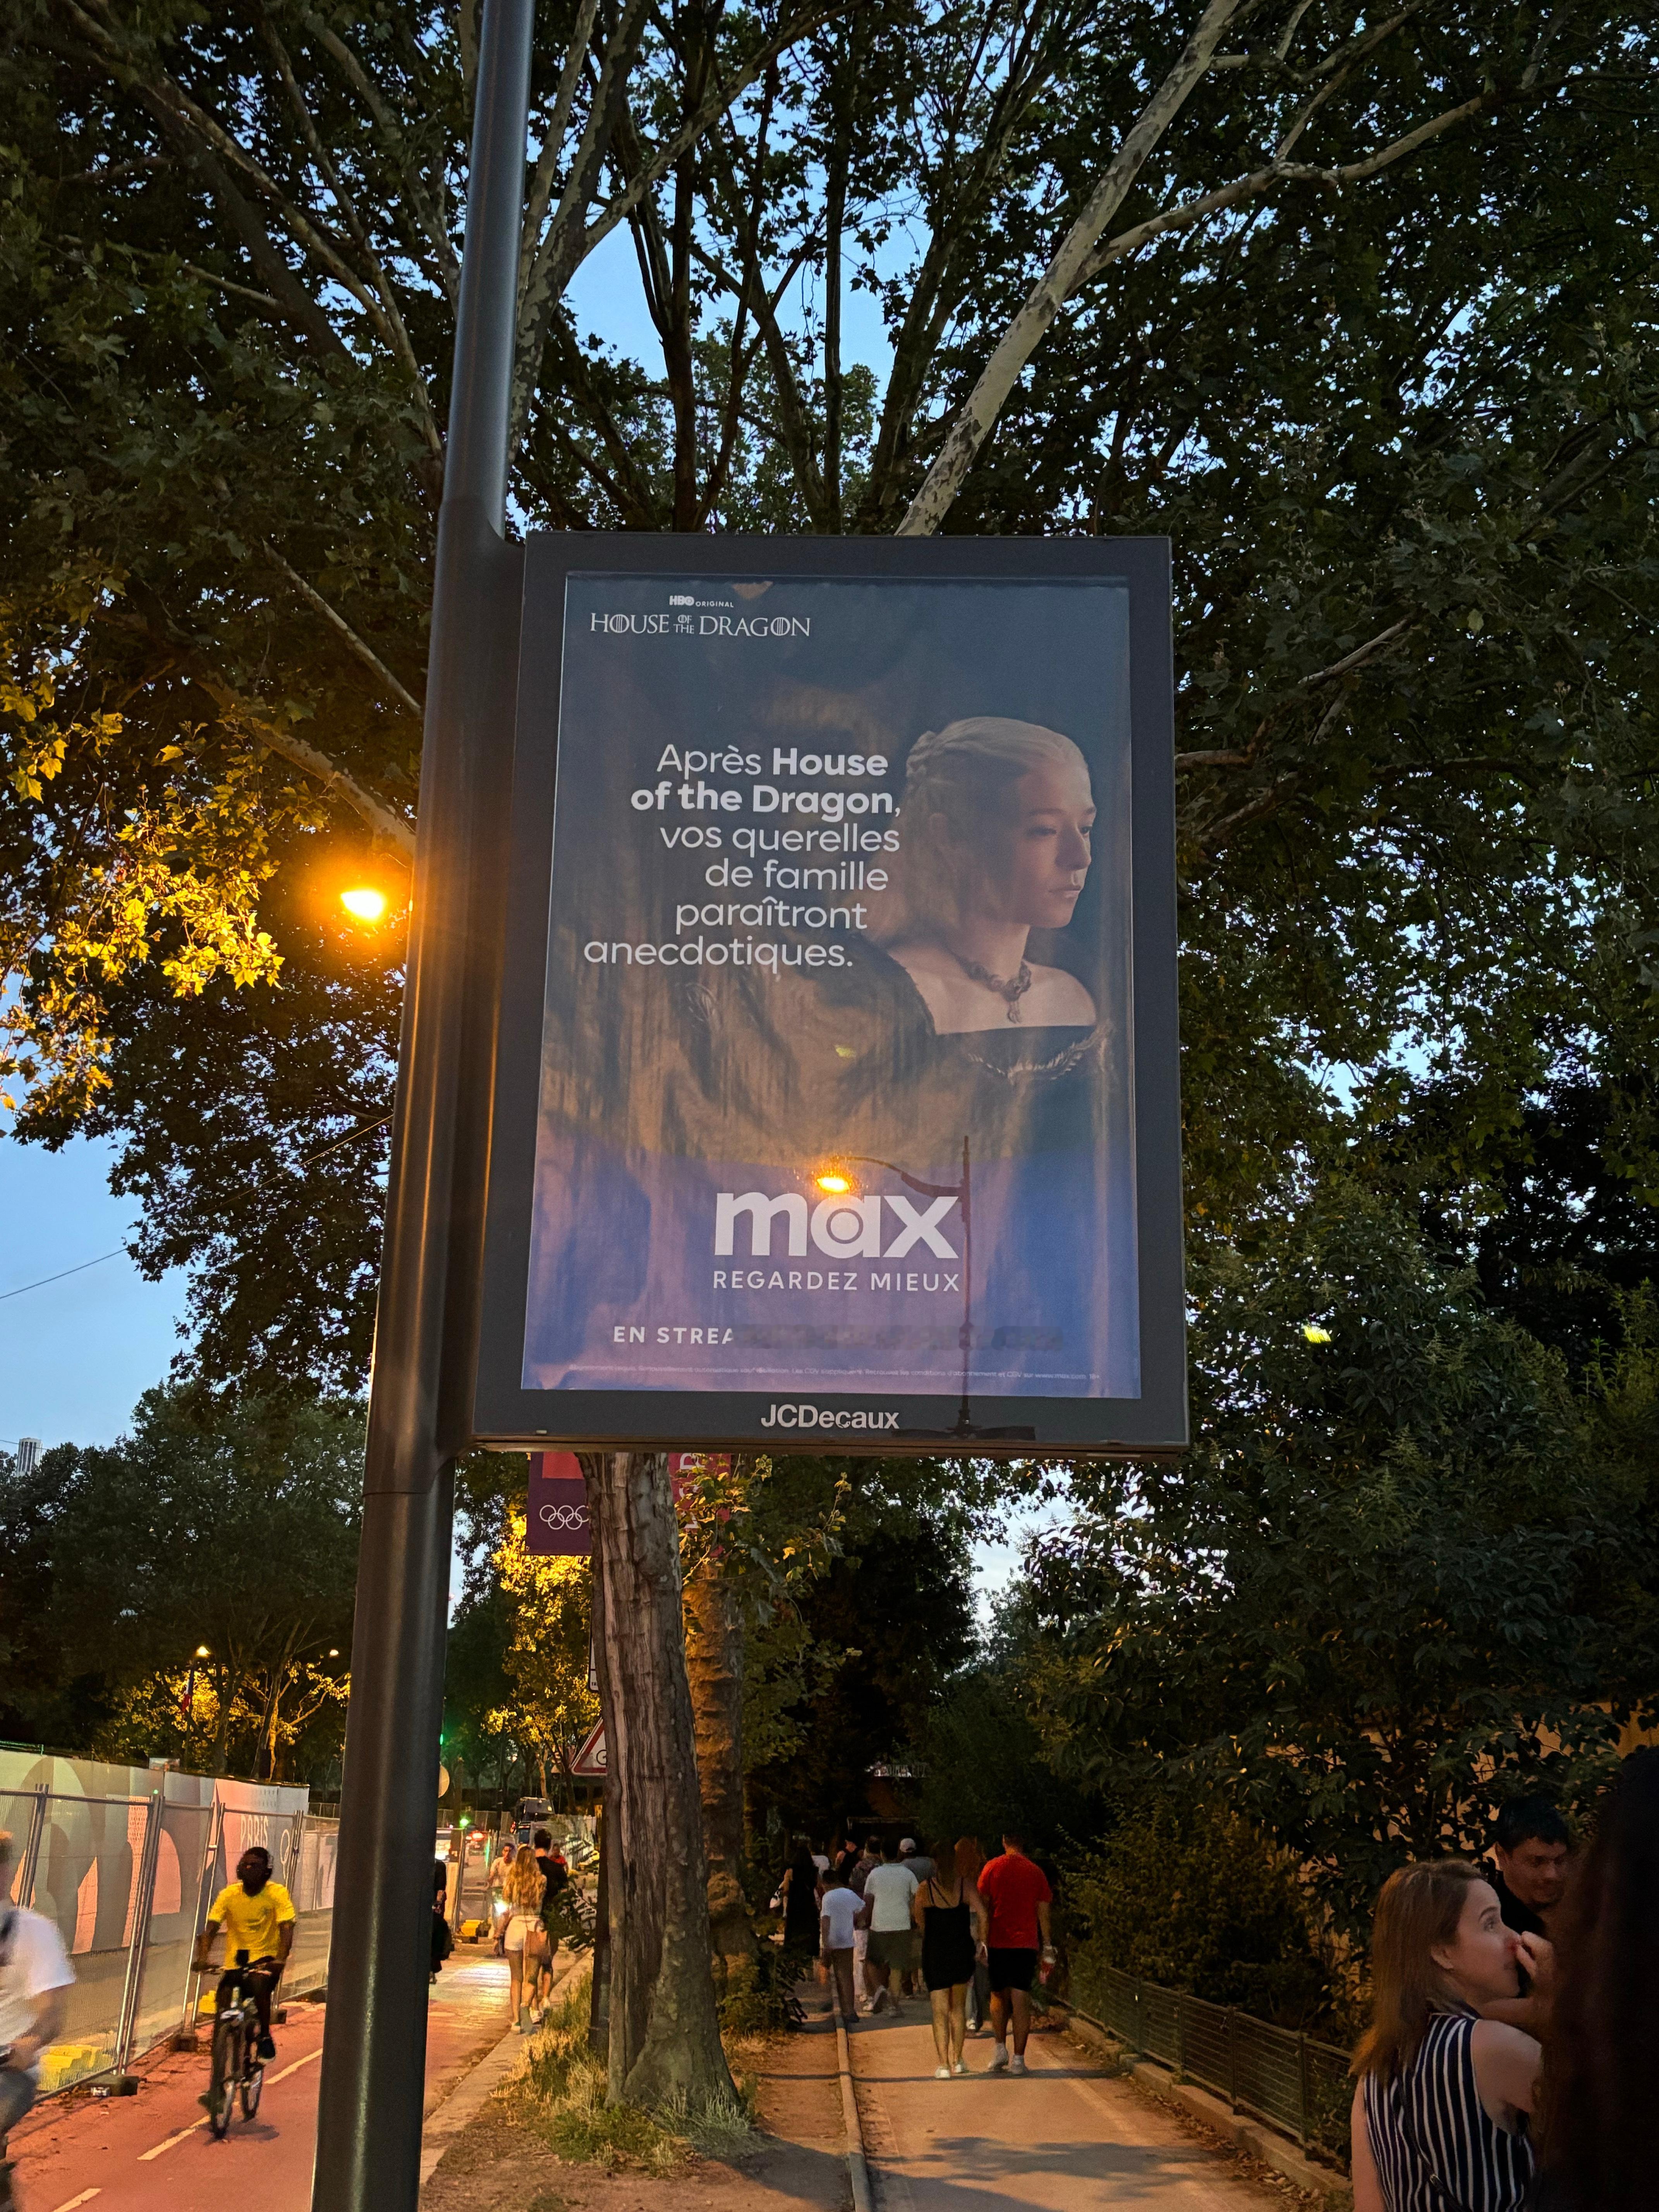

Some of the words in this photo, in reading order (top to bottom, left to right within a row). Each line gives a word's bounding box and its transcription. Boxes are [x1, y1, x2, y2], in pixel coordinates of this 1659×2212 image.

[670, 596, 694, 606] HBO
[591, 613, 669, 634] HOUSE
[673, 624, 694, 634] THE
[678, 615, 692, 624] OF
[699, 616, 811, 637] DRAGON
[657, 744, 761, 780] Après
[773, 748, 888, 776] House
[631, 781, 672, 810] of
[678, 781, 742, 811] the
[753, 785, 900, 822] Dragon,
[660, 827, 721, 848] vos
[733, 823, 900, 857] querelles
[706, 858, 754, 887] de
[764, 859, 888, 891] famille
[676, 896, 867, 934] paraîtront
[584, 936, 852, 974] anecdotiques.
[715, 1192, 958, 1259] max
[714, 1271, 857, 1290] REGARDEZ
[871, 1273, 959, 1291] MIEUX
[614, 1326, 645, 1343] EN
[761, 1404, 899, 1429] JCDecaux
